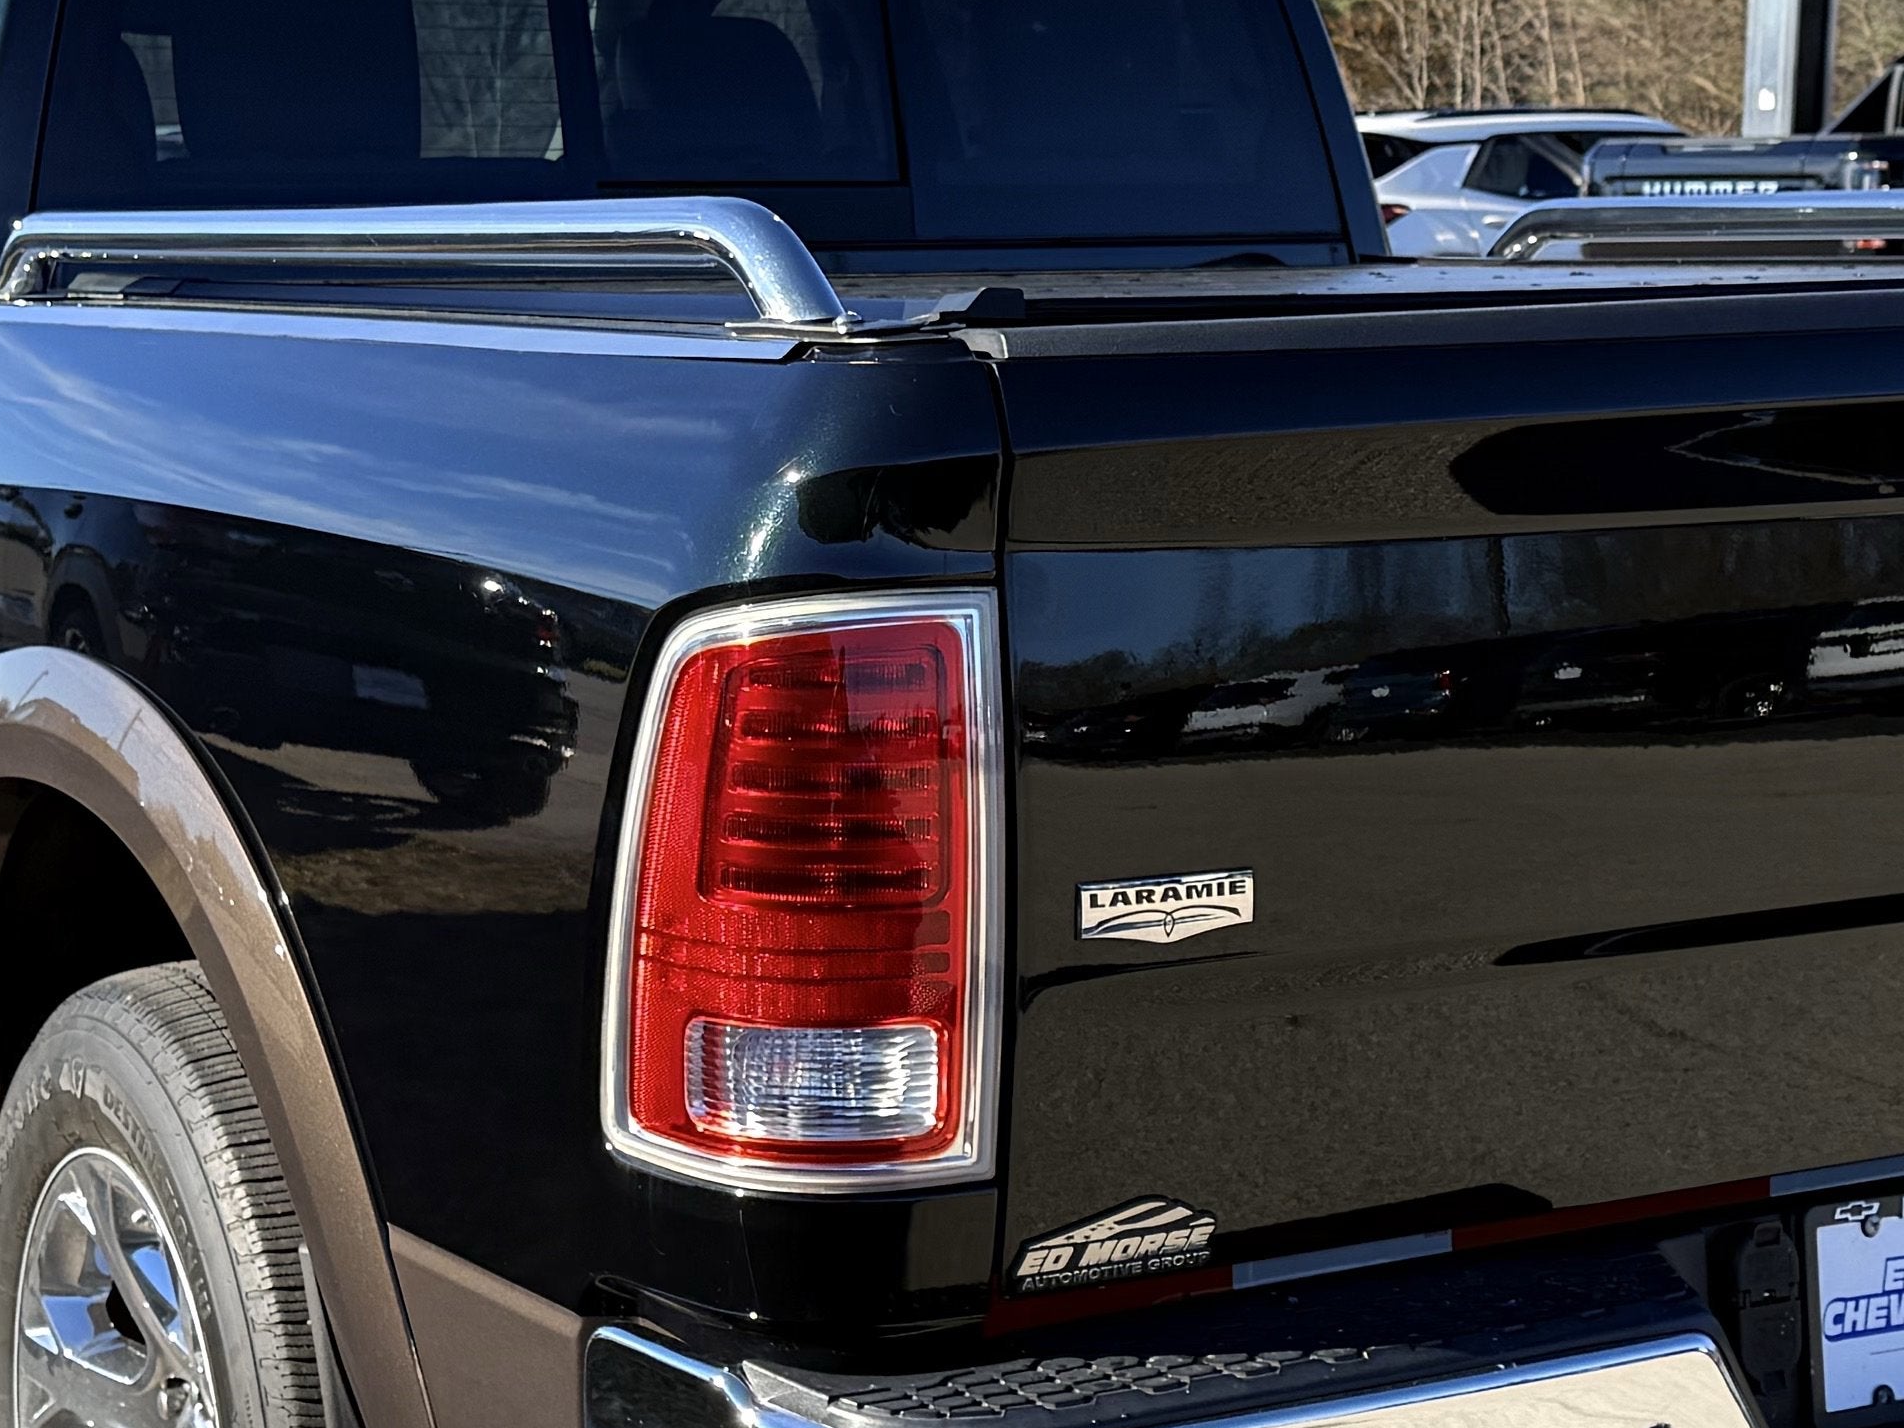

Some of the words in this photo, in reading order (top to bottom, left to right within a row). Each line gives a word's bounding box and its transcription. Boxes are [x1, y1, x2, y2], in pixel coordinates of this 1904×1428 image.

[1088, 878, 1248, 910] LARAMIE
[1016, 1246, 1075, 1277] ED
[1078, 1225, 1216, 1267] MORSE
[1021, 1260, 1143, 1291] AUTOMOTIVE
[1147, 1250, 1211, 1272] GROUP
